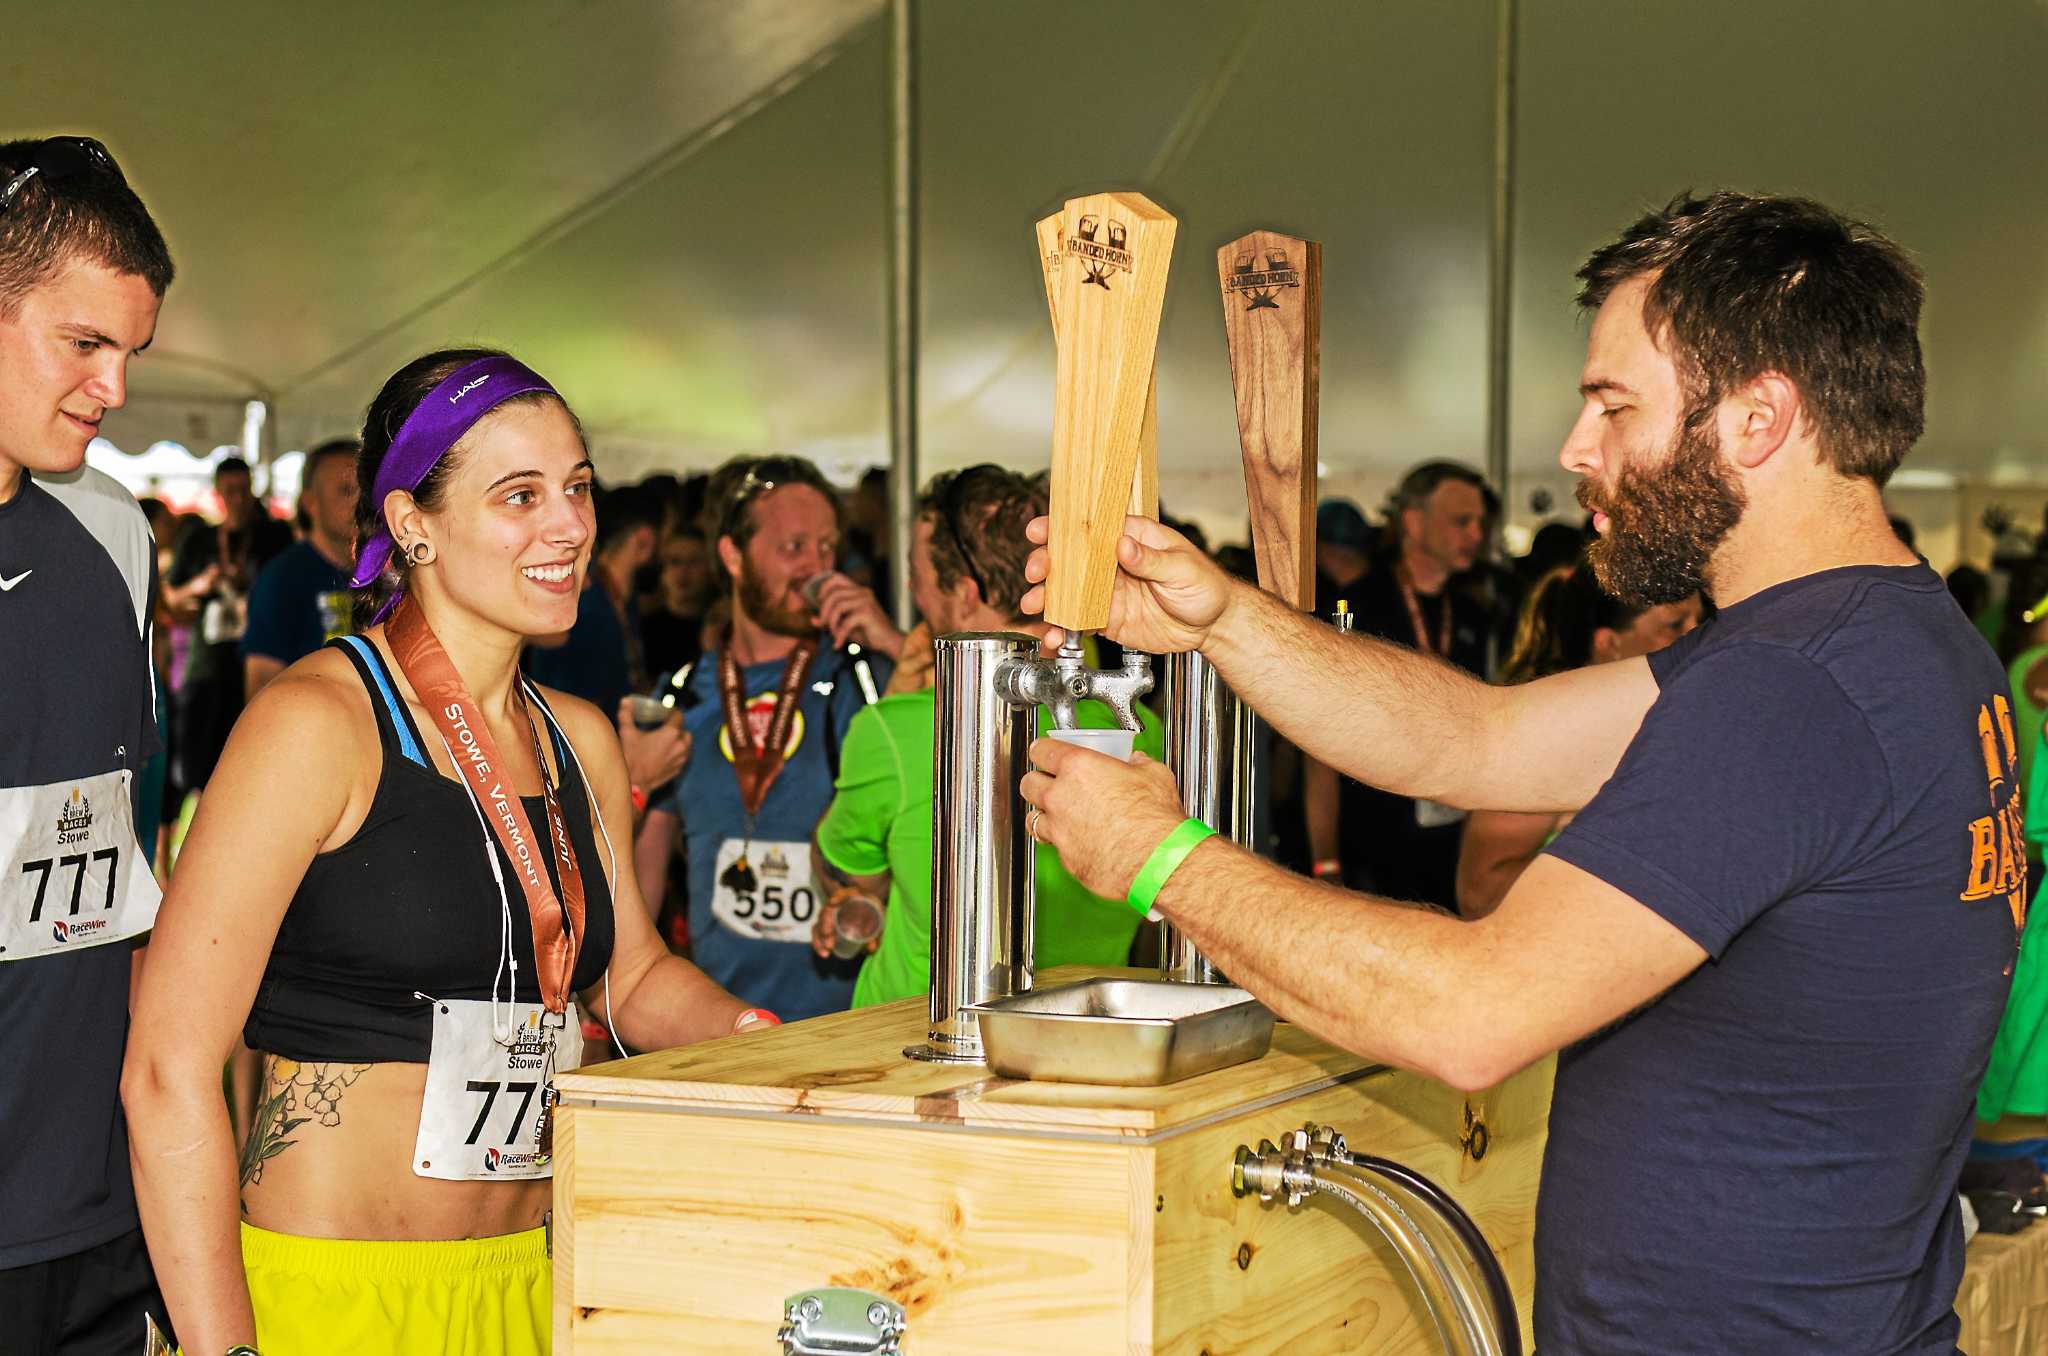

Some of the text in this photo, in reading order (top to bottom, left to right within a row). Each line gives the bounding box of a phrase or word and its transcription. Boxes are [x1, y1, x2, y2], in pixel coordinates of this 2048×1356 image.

[1072, 239, 1105, 261] BANDED
[1105, 249, 1128, 266] HORN
[444, 703, 540, 887] STOWE, VERMONT
[63, 818, 88, 831] RACES
[57, 830, 90, 845] Stowe
[22, 846, 120, 923] 777
[733, 886, 815, 922] 550
[69, 919, 107, 935] RaceWire
[514, 1044, 542, 1055] RACES
[507, 1055, 543, 1069] Stowe
[464, 1080, 538, 1145] 77
